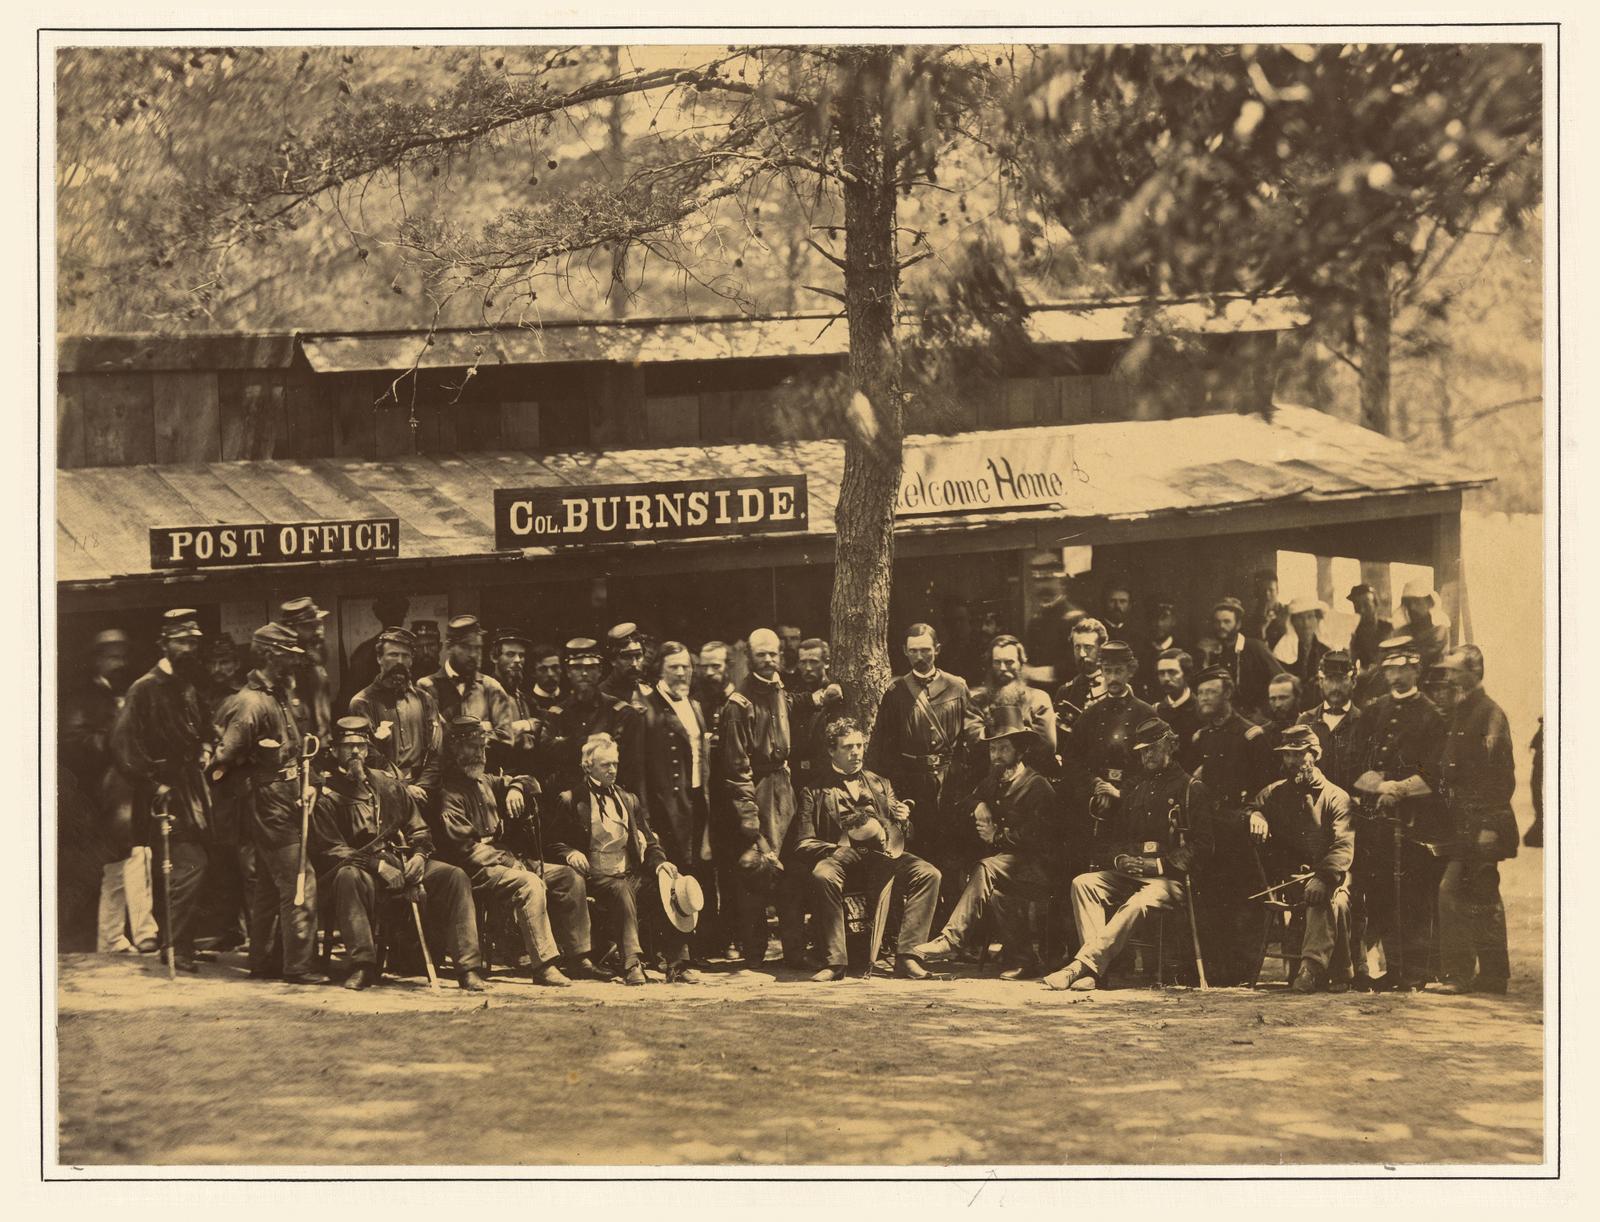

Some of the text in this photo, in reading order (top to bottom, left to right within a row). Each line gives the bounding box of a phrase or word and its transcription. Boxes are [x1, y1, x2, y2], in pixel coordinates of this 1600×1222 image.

[895, 470, 991, 508] elcome
[168, 522, 397, 561] POST OFFICE.
